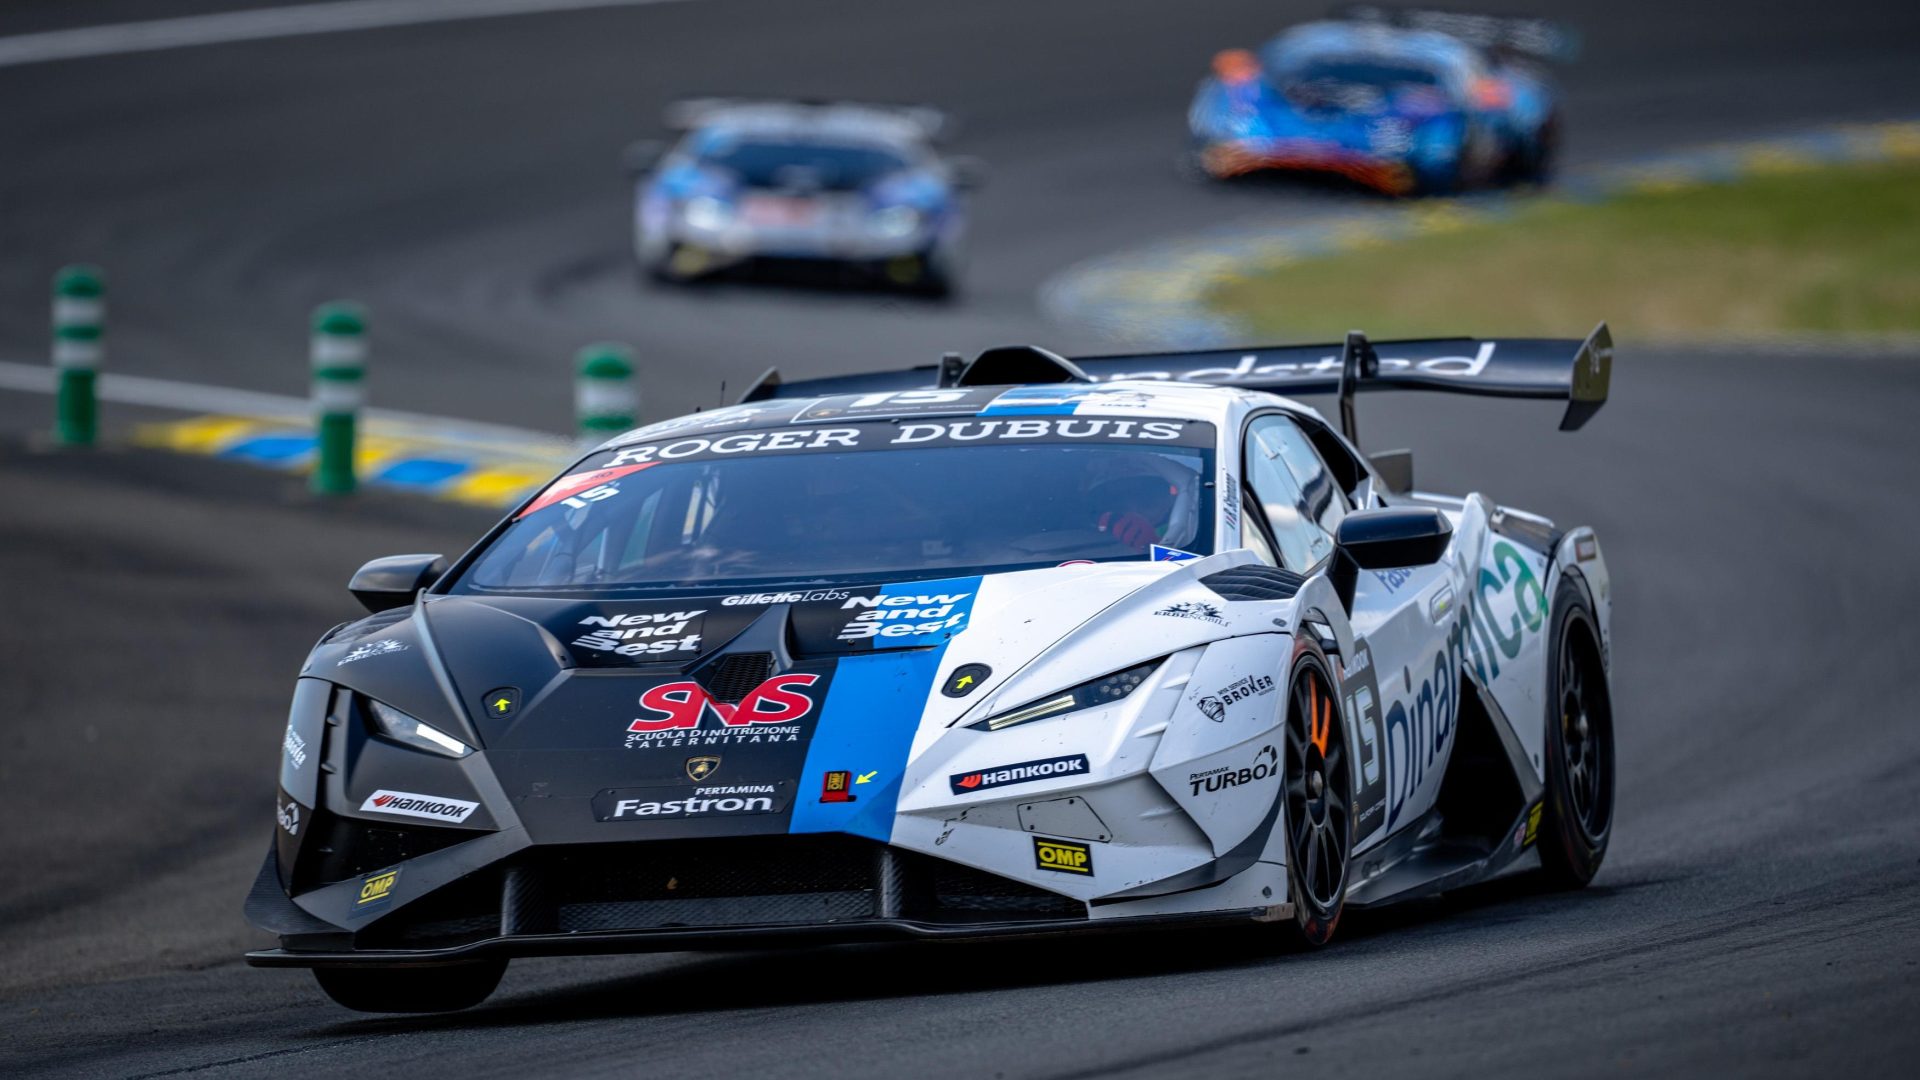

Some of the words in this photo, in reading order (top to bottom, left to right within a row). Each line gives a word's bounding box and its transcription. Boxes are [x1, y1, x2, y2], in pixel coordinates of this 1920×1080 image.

[603, 428, 861, 468] ROGER
[890, 420, 1184, 444] DUBUIS
[560, 484, 621, 509] 15
[721, 589, 850, 606] GilletteLabs
[840, 592, 972, 609] New
[578, 609, 708, 628] New
[855, 604, 954, 621] and
[591, 620, 690, 640] and
[837, 611, 966, 639] Best
[571, 634, 703, 656] Best
[1223, 674, 1274, 706] BROKER
[624, 734, 798, 749] SALERNITANA
[626, 730, 686, 742] SCUOLA
[689, 729, 706, 737] DI
[709, 726, 801, 737] NUTRIZIONE
[1346, 685, 1379, 795] 15
[695, 785, 775, 796] PERTAMINA
[1190, 763, 1268, 797] TURBO
[613, 796, 773, 818] Fastron
[1039, 846, 1087, 867] OMP
[360, 876, 395, 899] OMP
